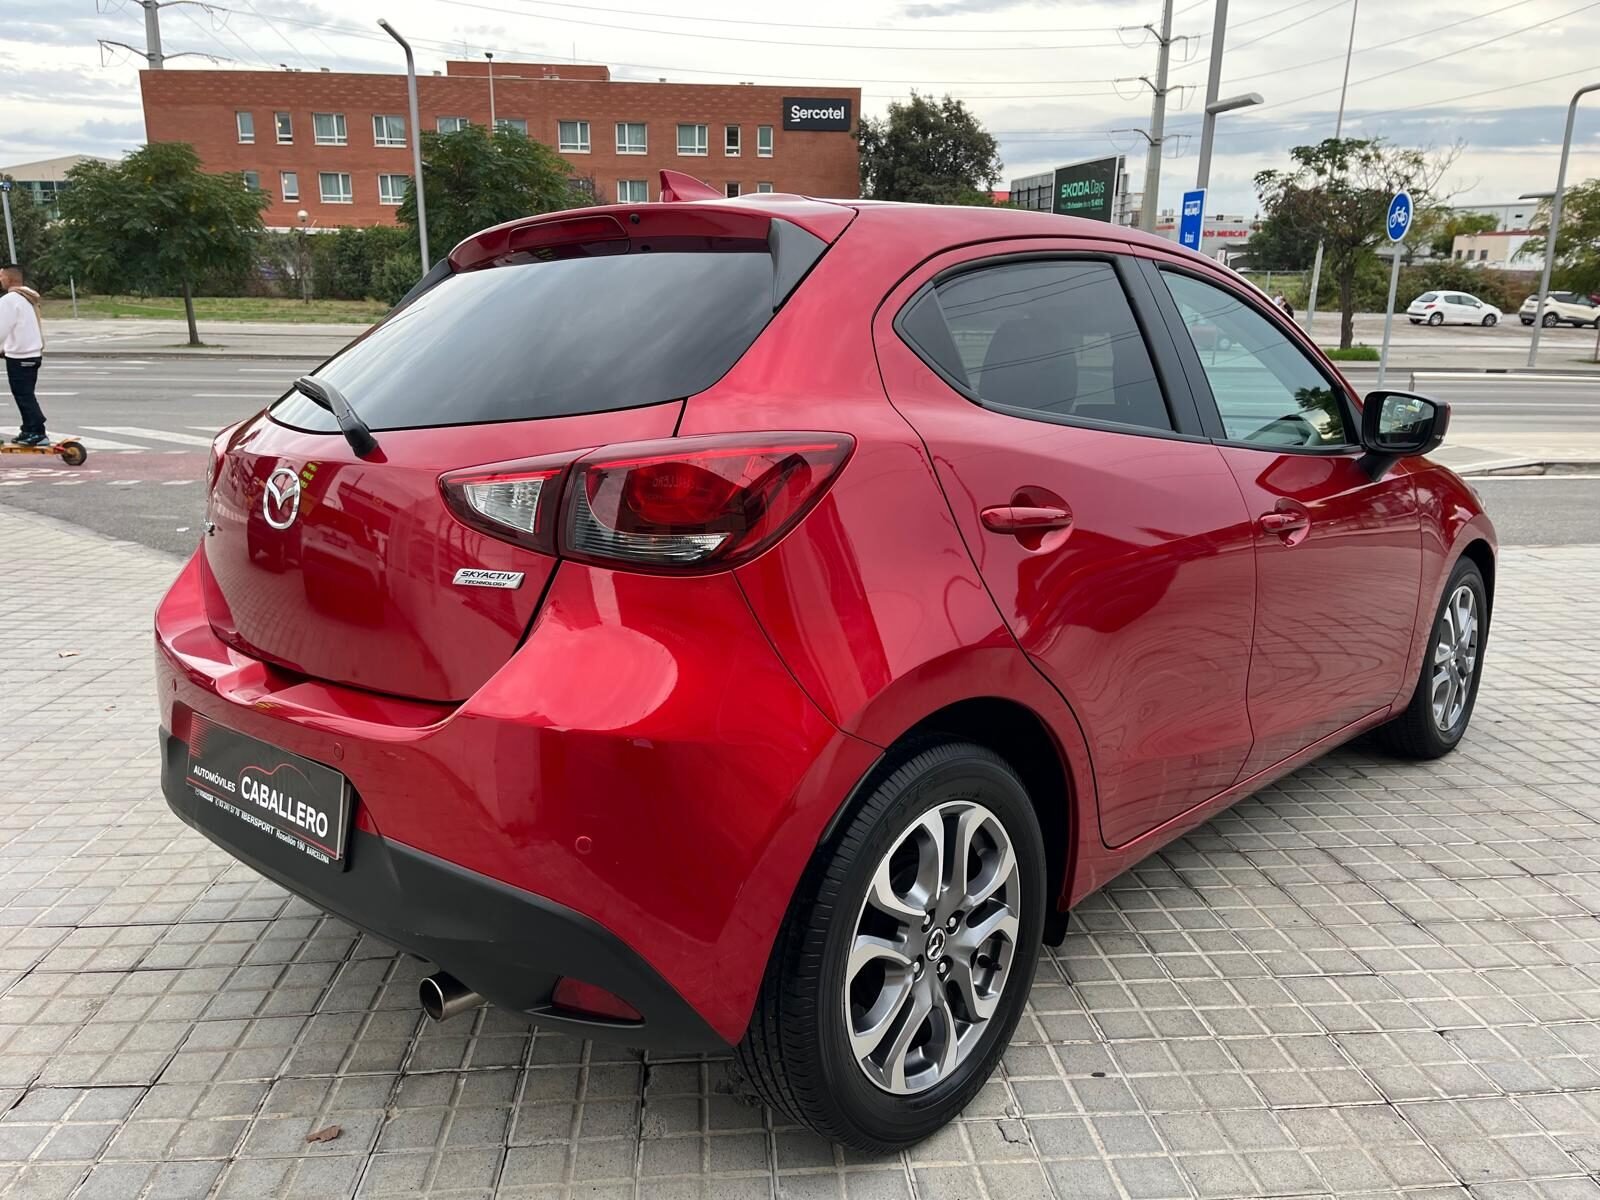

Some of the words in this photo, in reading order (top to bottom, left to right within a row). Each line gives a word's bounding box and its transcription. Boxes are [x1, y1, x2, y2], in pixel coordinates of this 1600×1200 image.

[790, 105, 845, 121] Sercotel
[1216, 230, 1248, 238] MERCAT
[460, 570, 516, 580] SKYACTIV
[464, 579, 507, 587] TECHNOLOGY
[193, 765, 236, 792] AUTOMÓVILES
[241, 776, 328, 838] CABALLERO
